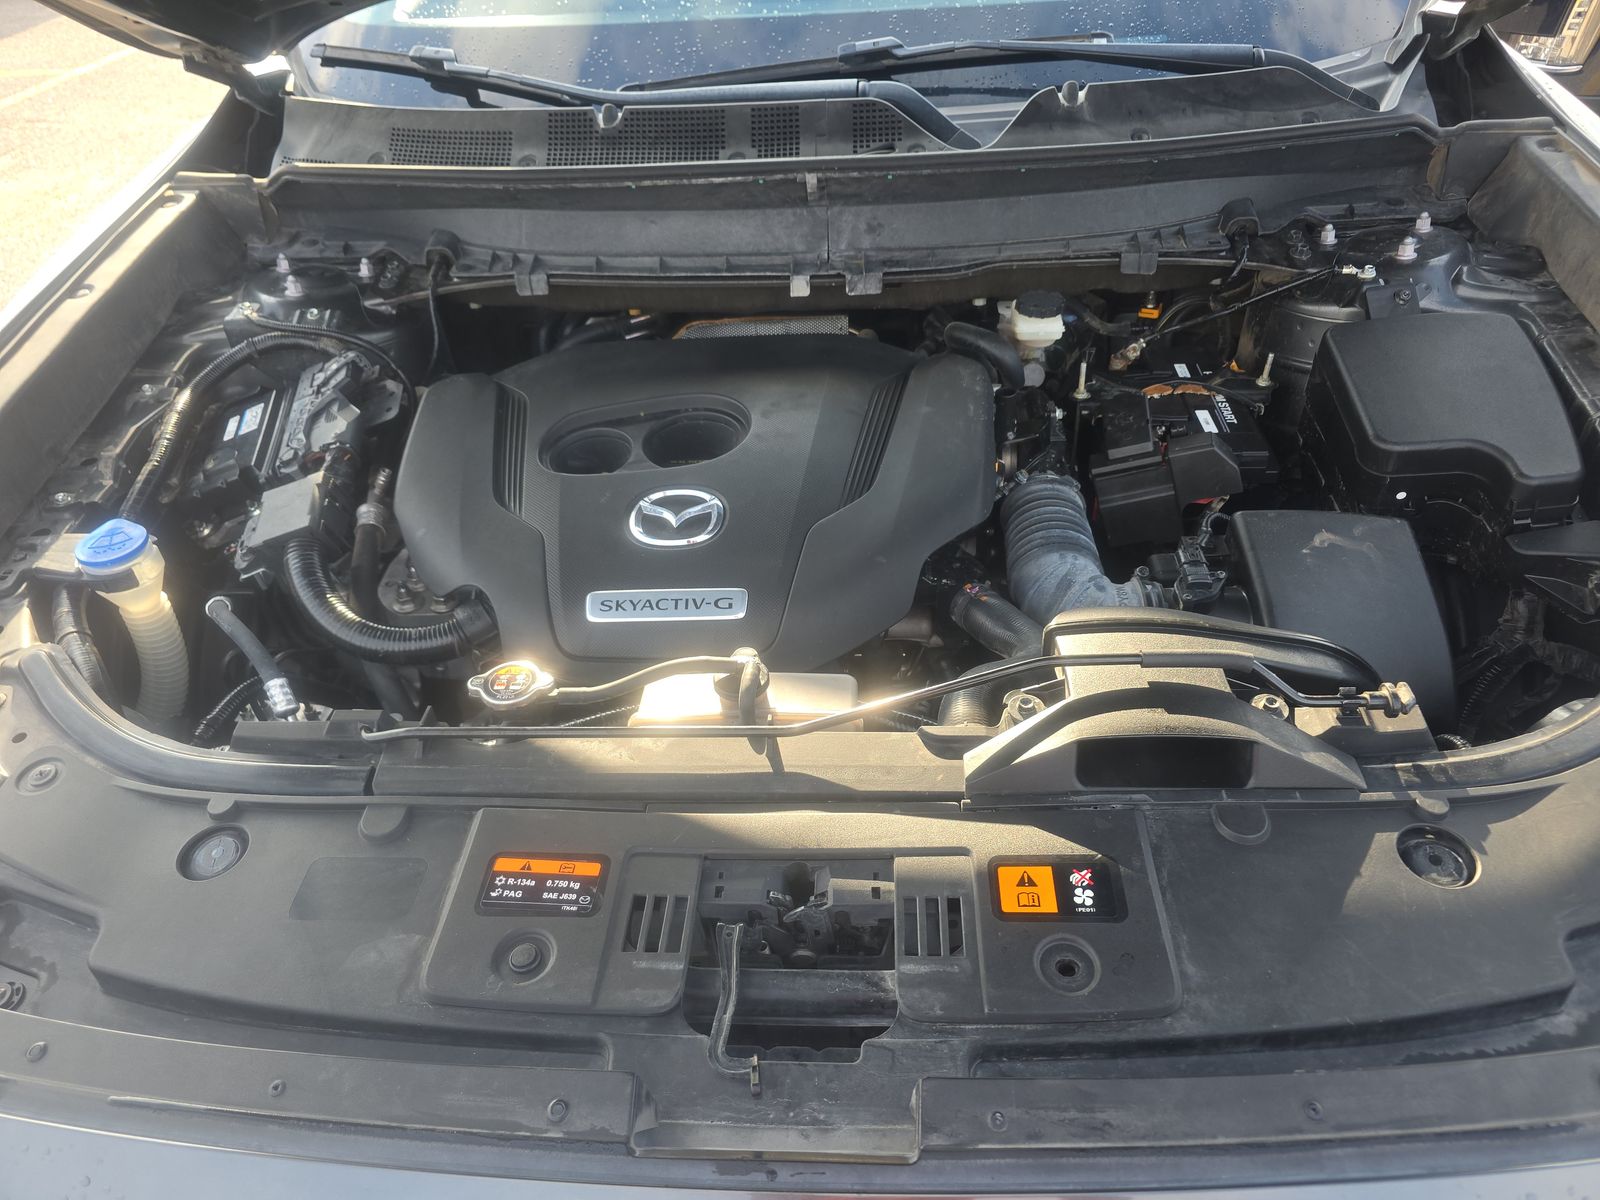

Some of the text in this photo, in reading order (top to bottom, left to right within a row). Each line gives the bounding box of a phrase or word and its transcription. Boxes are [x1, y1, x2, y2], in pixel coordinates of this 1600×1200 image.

[1218, 402, 1238, 424] START
[599, 597, 734, 612] SKYACTIV-G
[507, 878, 581, 890] R-134a 0.750 kg
[502, 890, 523, 898] PAG
[559, 892, 577, 900] J639
